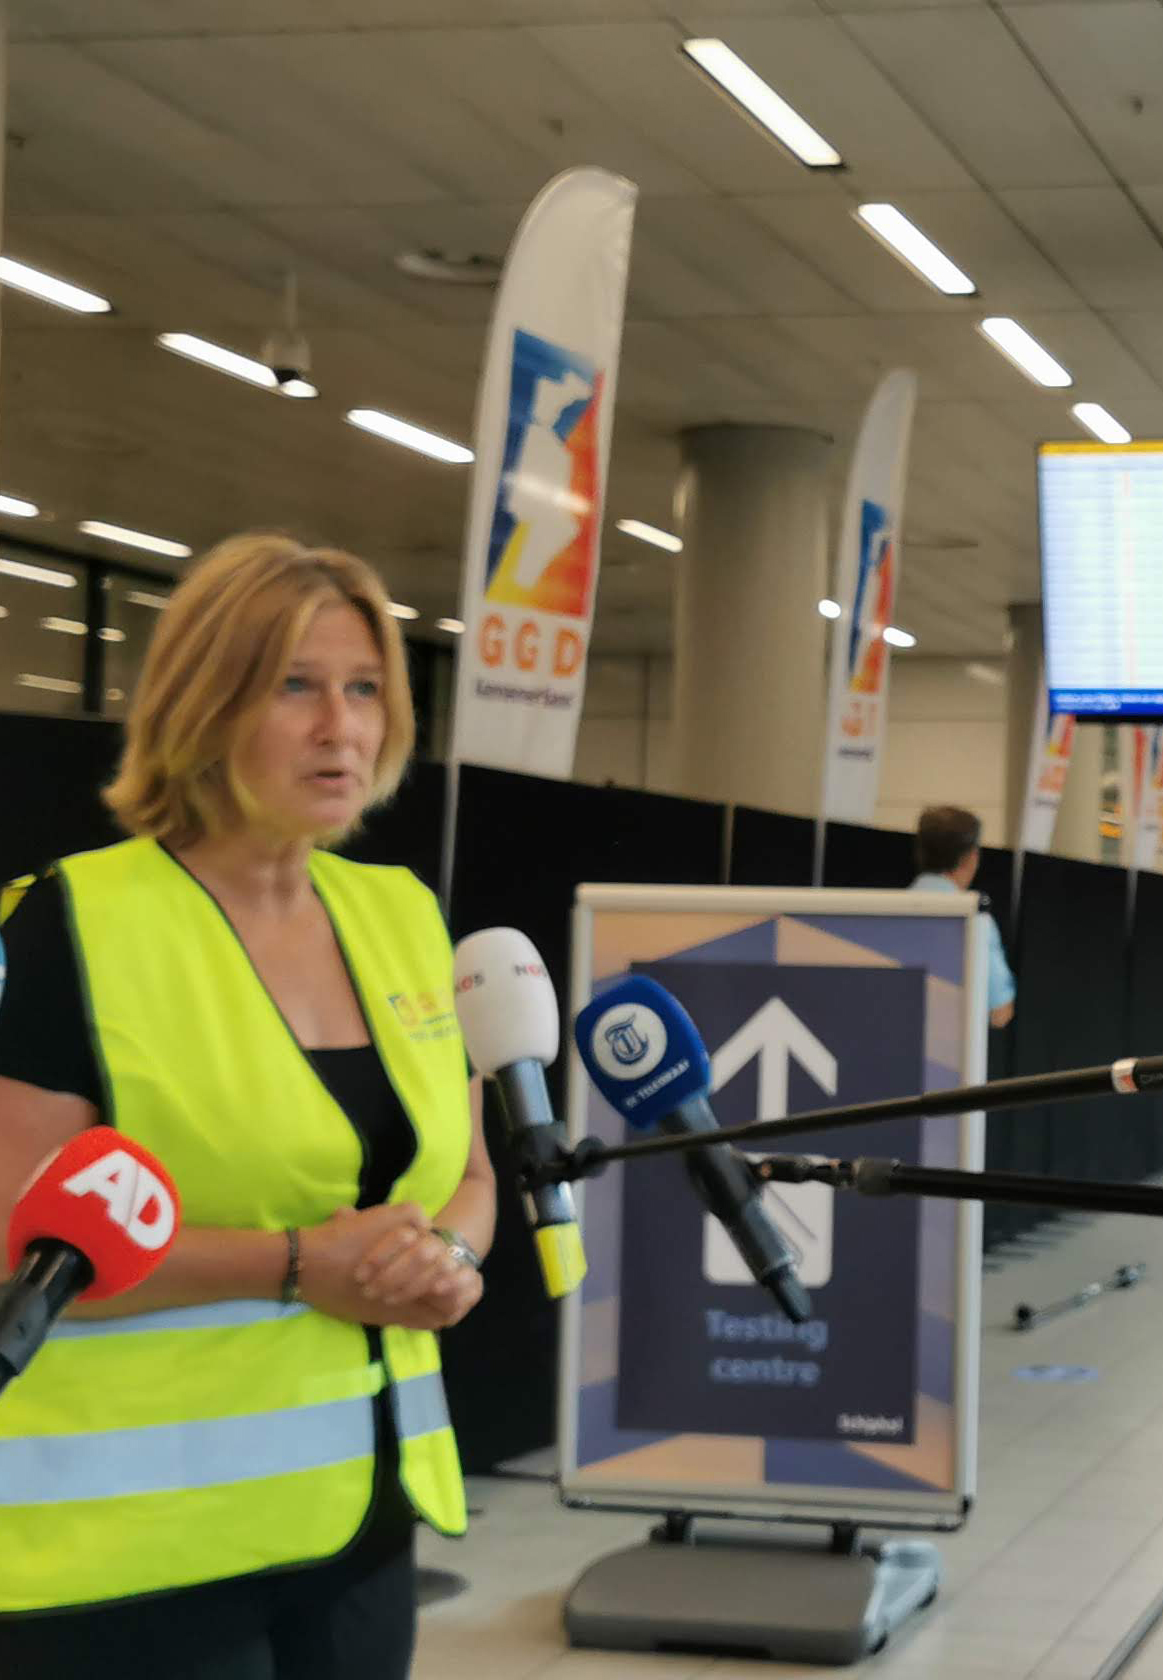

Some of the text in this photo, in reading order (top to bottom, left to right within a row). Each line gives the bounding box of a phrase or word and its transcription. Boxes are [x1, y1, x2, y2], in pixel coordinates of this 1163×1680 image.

[477, 612, 586, 679] GGD
[60, 1148, 175, 1251] AD
[705, 1310, 829, 1352] Testing
[710, 1357, 821, 1387] centre
